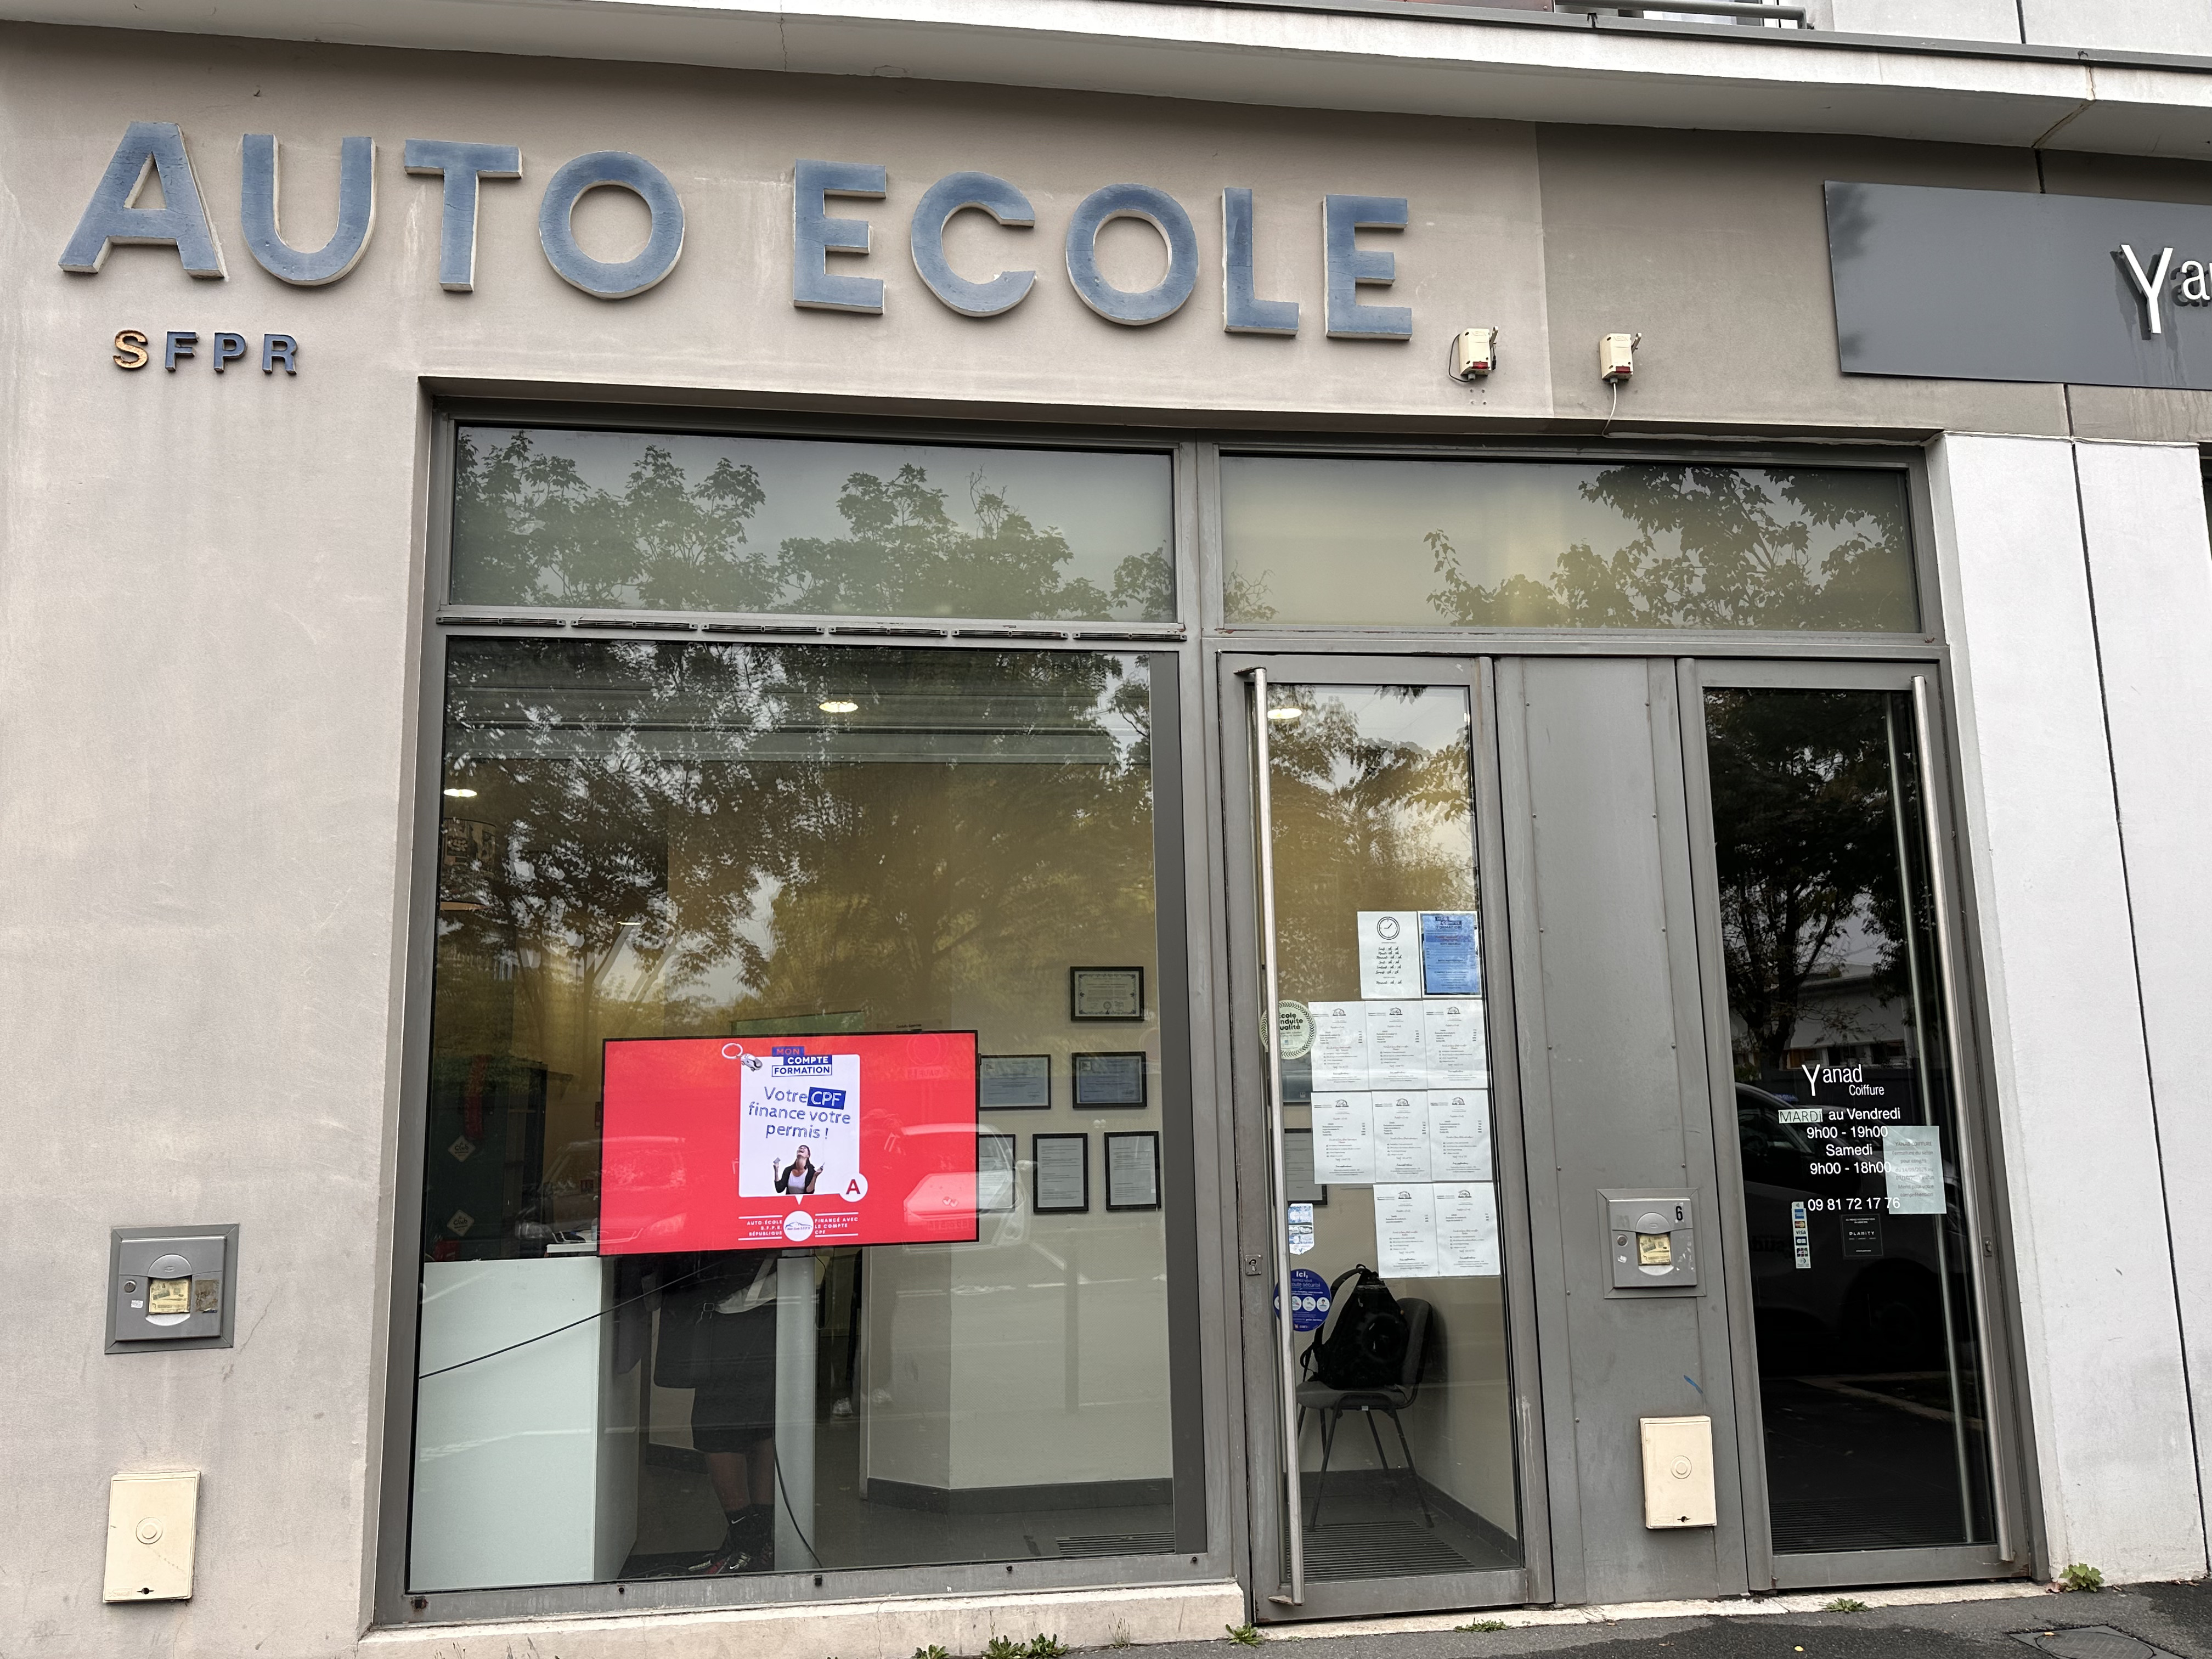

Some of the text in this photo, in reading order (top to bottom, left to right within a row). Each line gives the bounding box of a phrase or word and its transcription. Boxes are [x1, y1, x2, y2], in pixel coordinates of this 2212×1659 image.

[58, 121, 1412, 341] AUTO ECOLE
[2120, 244, 2212, 334] Ya
[774, 1066, 830, 1075] FORMATION
[1802, 1064, 1863, 1096] Yanad
[764, 1086, 842, 1107] Votre CPF
[1849, 1084, 1884, 1096] Coiffure
[749, 1101, 851, 1124] finance votre
[1780, 1107, 1901, 1122] MARDI au Vendredi
[766, 1125, 820, 1138] permis
[1807, 1126, 1838, 1139] 9h00
[1850, 1126, 1888, 1138] 19h00
[1826, 1143, 1873, 1156] Samedi
[1810, 1163, 1841, 1175] 9h00
[1854, 1161, 1892, 1173] 18h00
[845, 1179, 861, 1195] A
[1808, 1197, 1900, 1211] 09 81 72 17 76
[1675, 1205, 1683, 1221] 6
